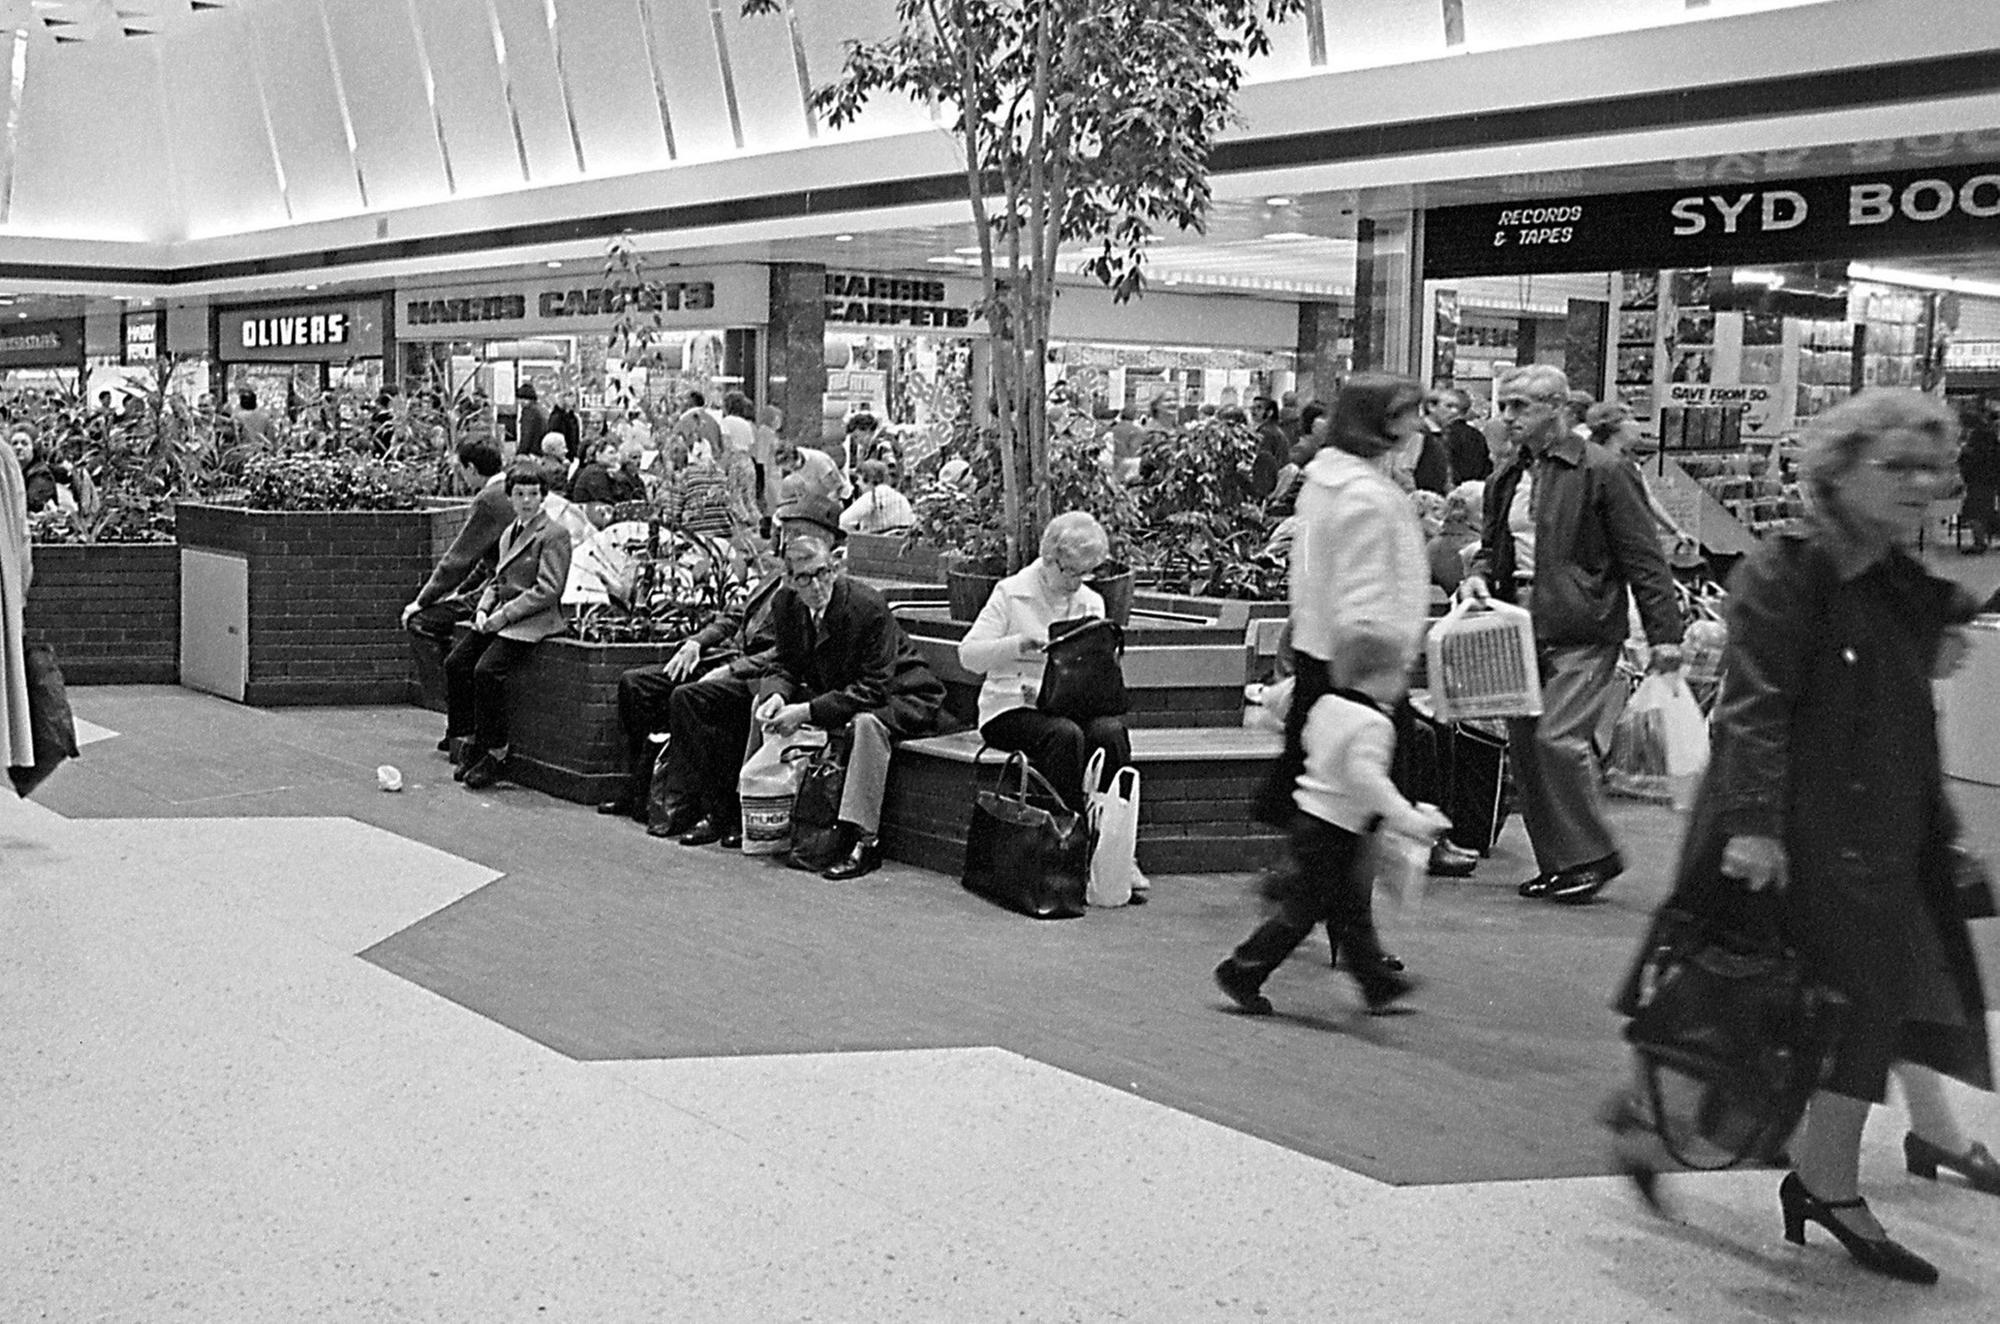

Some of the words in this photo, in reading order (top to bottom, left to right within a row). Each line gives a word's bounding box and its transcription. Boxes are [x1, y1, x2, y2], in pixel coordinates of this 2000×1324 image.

[1498, 205, 1582, 226] RECORDS
[1671, 190, 1808, 235] SYD
[1493, 231, 1507, 247] &
[1519, 227, 1573, 245] TAPES
[826, 274, 945, 301] HARRIS
[825, 302, 968, 327] CARPETS
[242, 314, 343, 347] OLIVERS
[1671, 387, 1704, 400] SAVE
[1710, 388, 1747, 400] FROM
